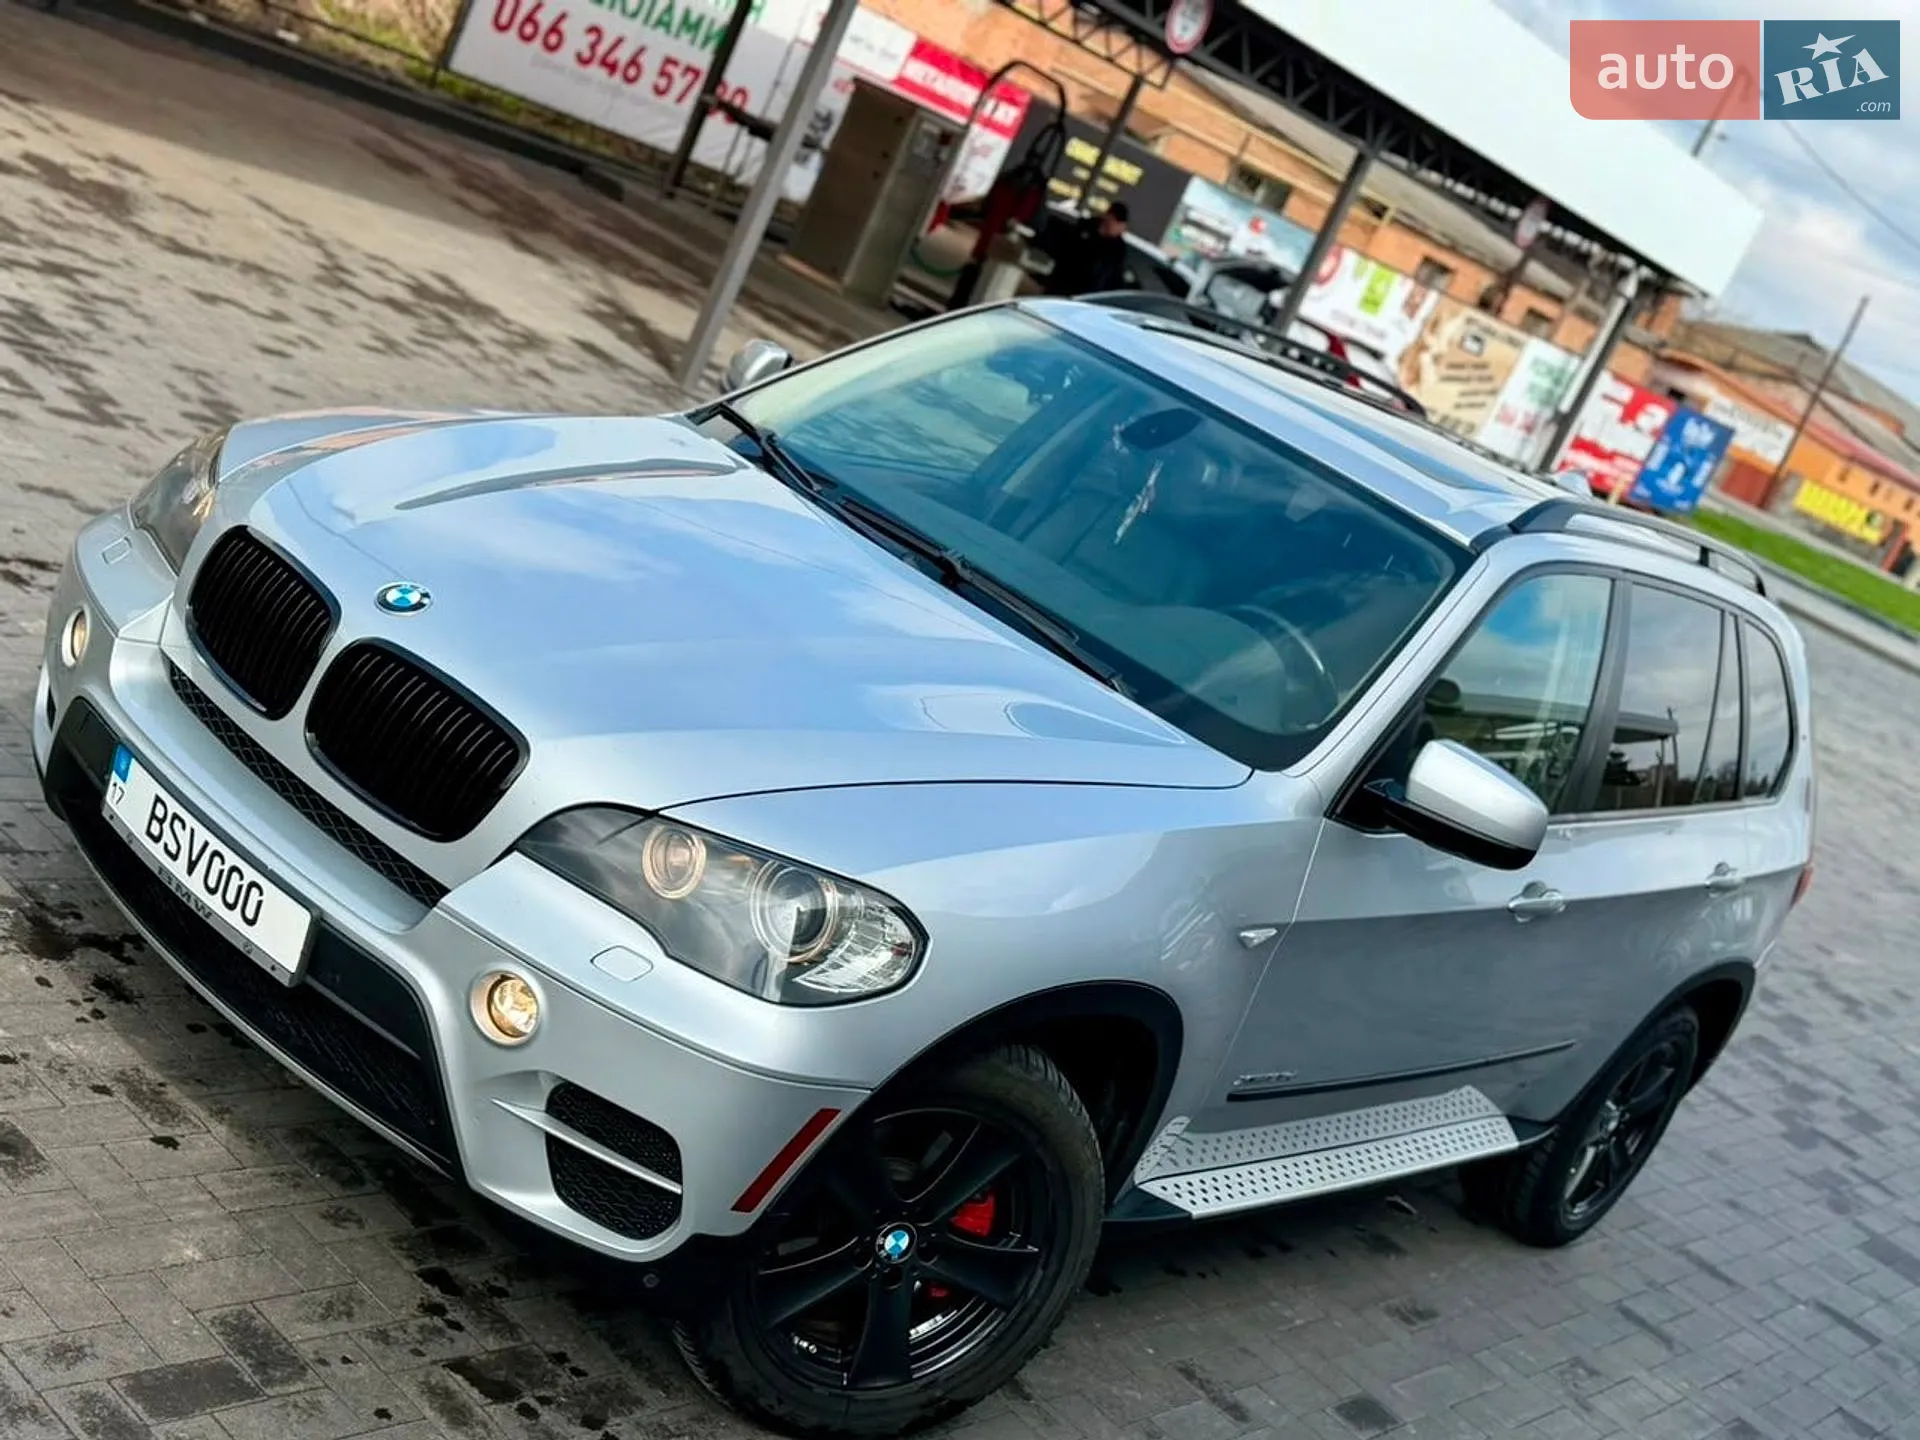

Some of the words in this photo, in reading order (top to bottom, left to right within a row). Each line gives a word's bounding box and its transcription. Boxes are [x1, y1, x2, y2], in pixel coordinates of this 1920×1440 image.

[494, 0, 566, 52] 066
[575, 25, 648, 84] 346
[652, 55, 703, 104] 57
[145, 793, 265, 927] BSV000
